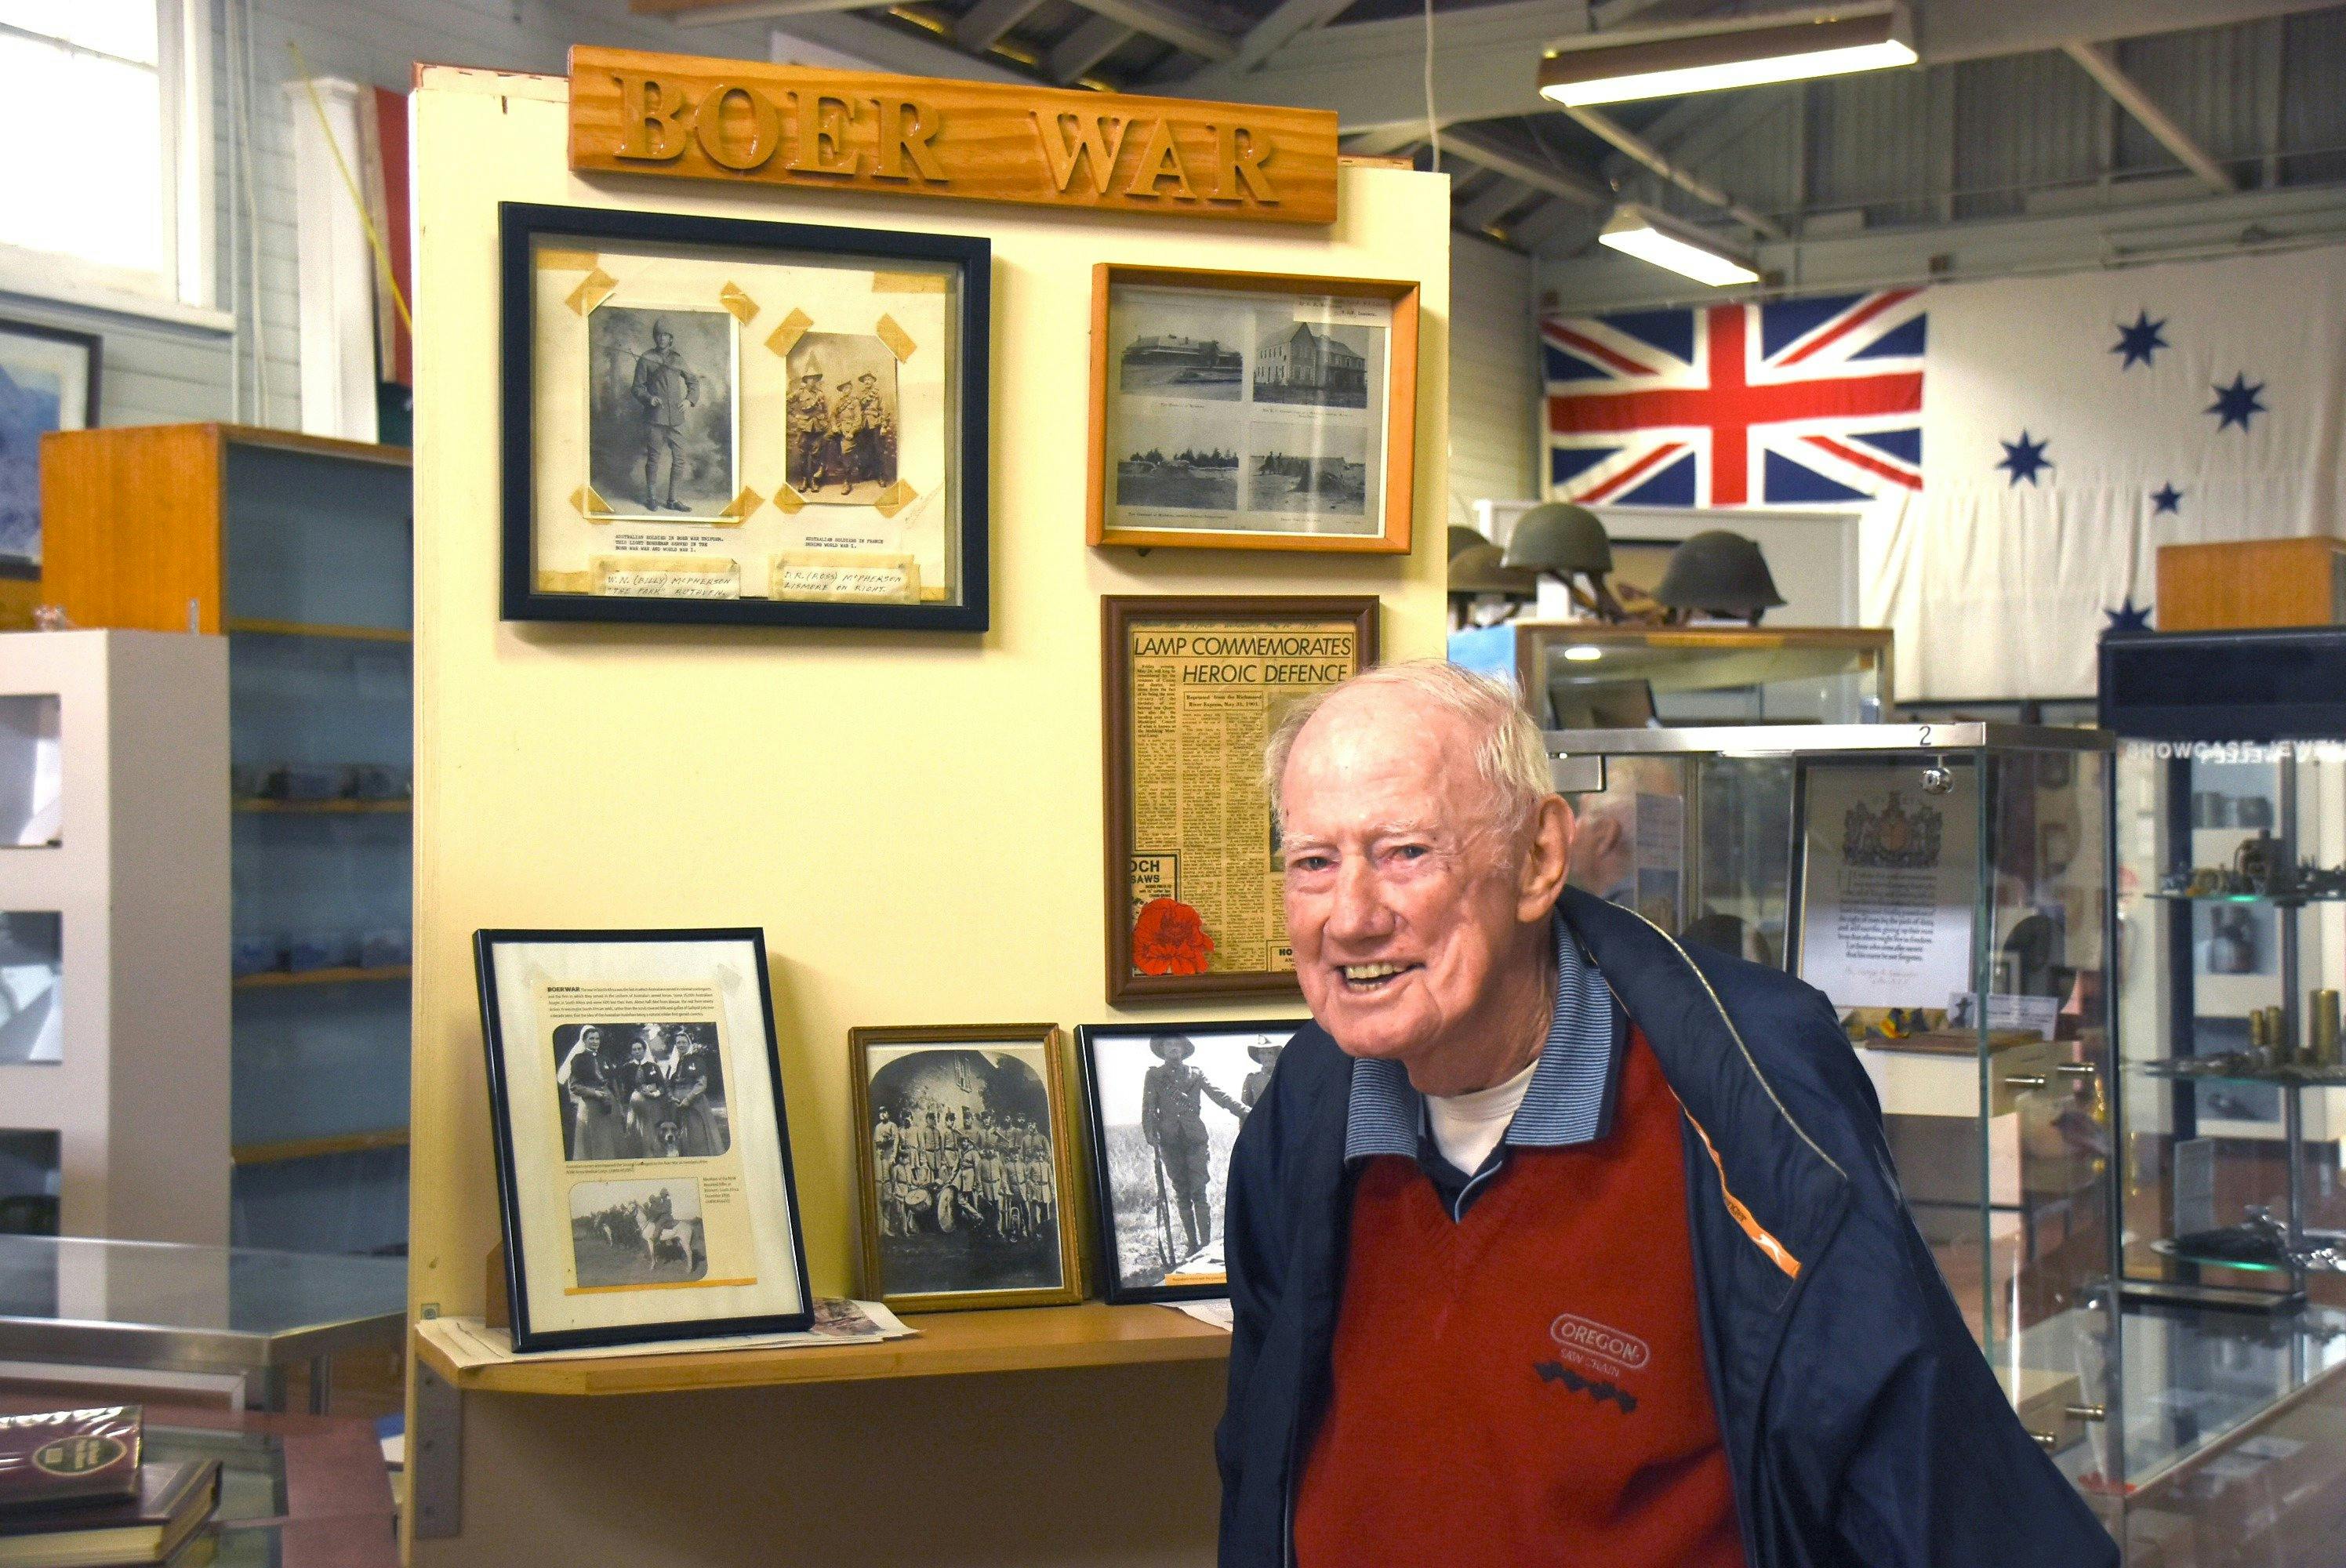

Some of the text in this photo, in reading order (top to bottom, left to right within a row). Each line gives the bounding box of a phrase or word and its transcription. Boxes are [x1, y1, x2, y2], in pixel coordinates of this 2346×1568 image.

[613, 75, 1280, 203] BOER WAR
[1135, 637, 1352, 656] LAMP COMMEMORATES
[1182, 664, 1348, 683] HEROIC DEFENCE
[1919, 725, 1933, 746] 2
[1561, 1322, 1640, 1361] OREGON
